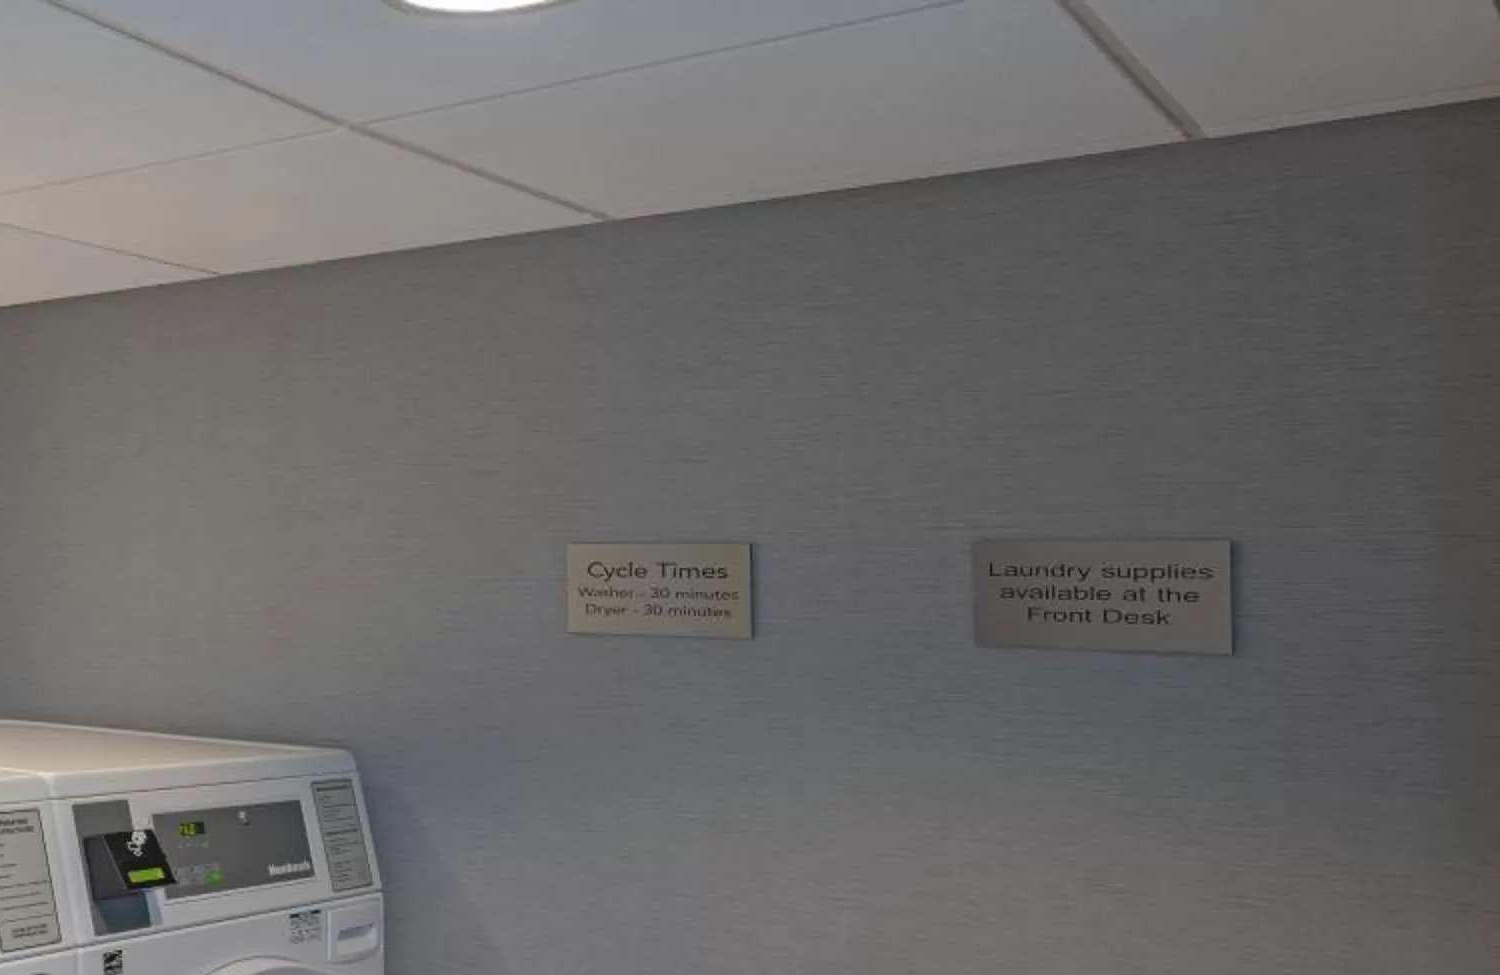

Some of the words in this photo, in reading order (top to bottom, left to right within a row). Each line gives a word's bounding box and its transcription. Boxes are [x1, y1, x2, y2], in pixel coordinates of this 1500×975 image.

[587, 561, 648, 582] Cycle
[656, 561, 729, 579] Times
[988, 562, 1091, 581] Laundry
[1101, 563, 1215, 582] supplies
[578, 586, 634, 600] Washer
[651, 587, 671, 599] 30
[675, 588, 740, 601] minutes
[999, 585, 1112, 601] available
[1122, 587, 1147, 602] at
[1157, 587, 1201, 603] the
[585, 603, 628, 617] Dryer
[643, 604, 663, 616] 30
[667, 605, 731, 618] minutes
[1026, 607, 1092, 623] Front
[1102, 608, 1171, 625] Desk
